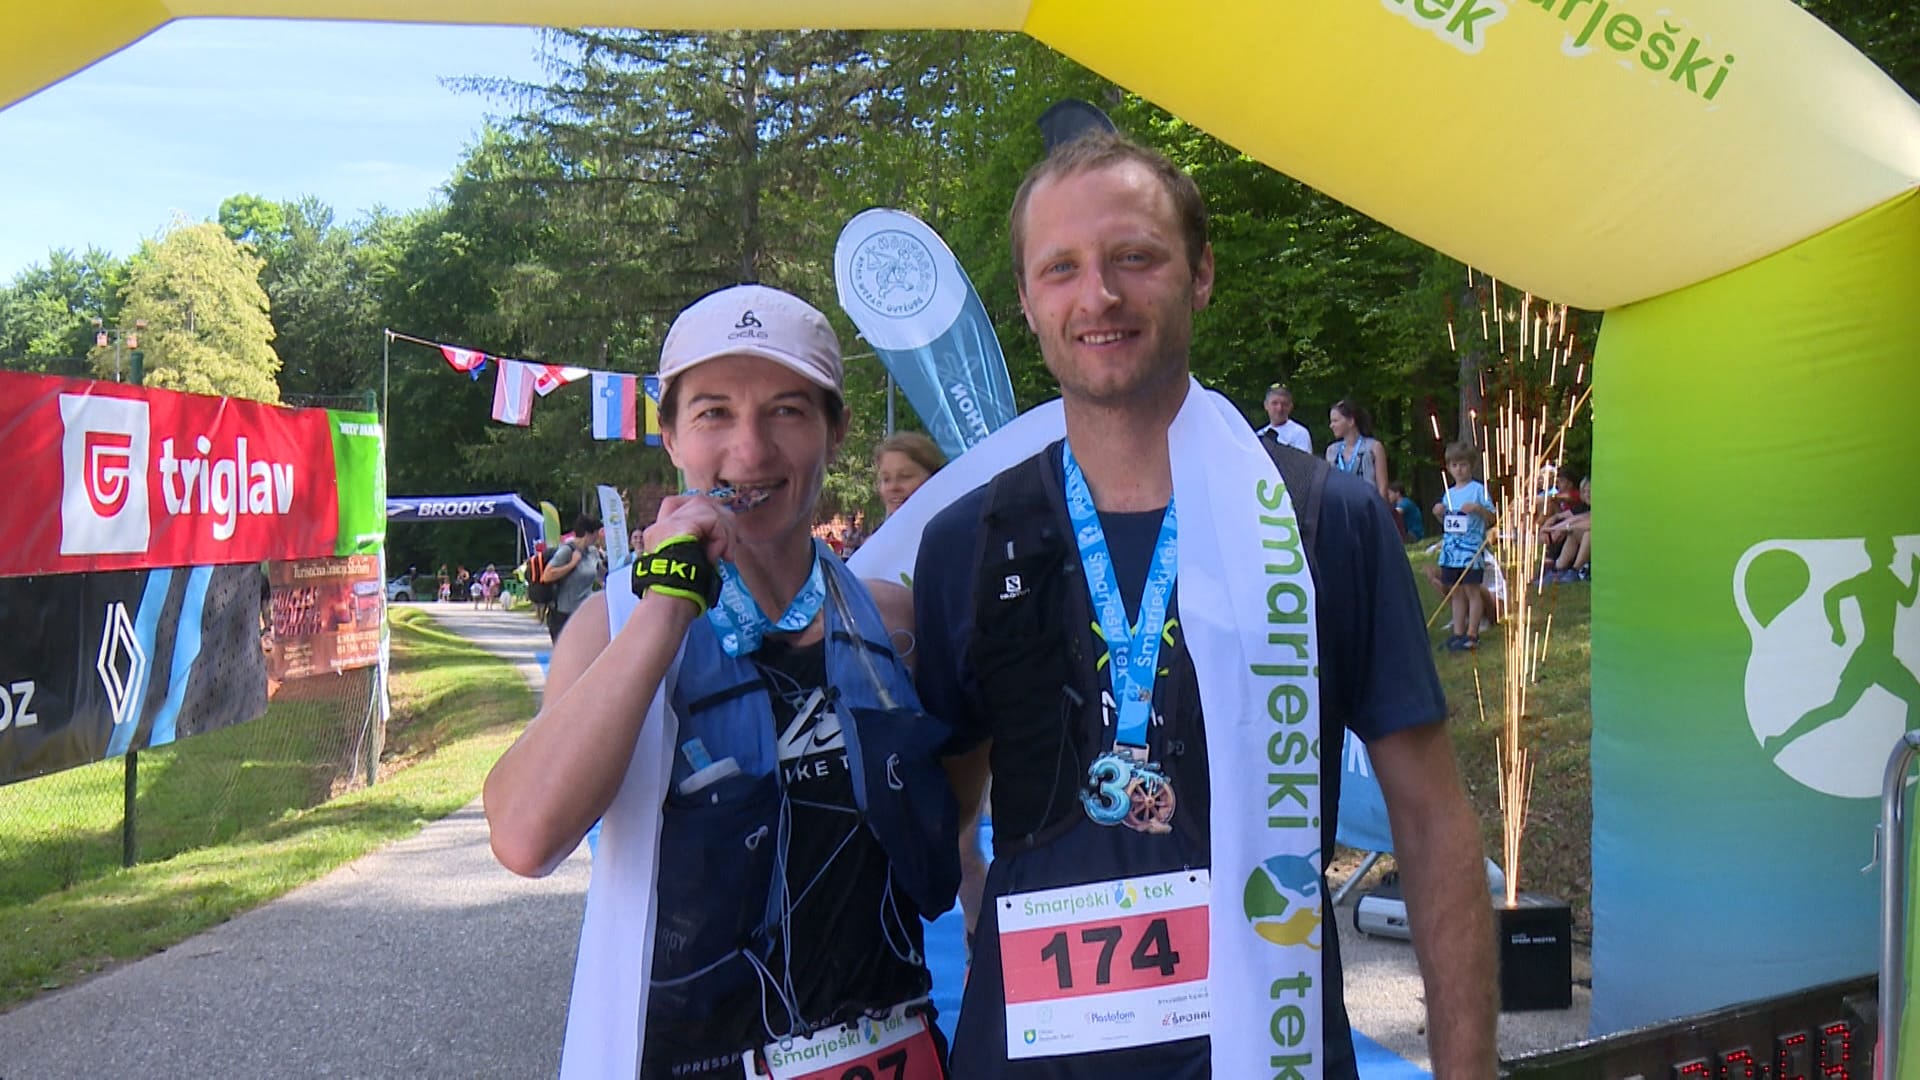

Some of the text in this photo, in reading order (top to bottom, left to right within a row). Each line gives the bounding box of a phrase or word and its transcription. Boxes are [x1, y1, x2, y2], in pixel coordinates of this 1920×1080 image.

[159, 434, 294, 541] triglav
[417, 501, 497, 516] BROOKS
[636, 558, 697, 581] LEKI
[1023, 881, 1174, 916] Šmarješki tek
[1040, 918, 1180, 990] 174
[772, 1031, 861, 1068] Šmarješki
